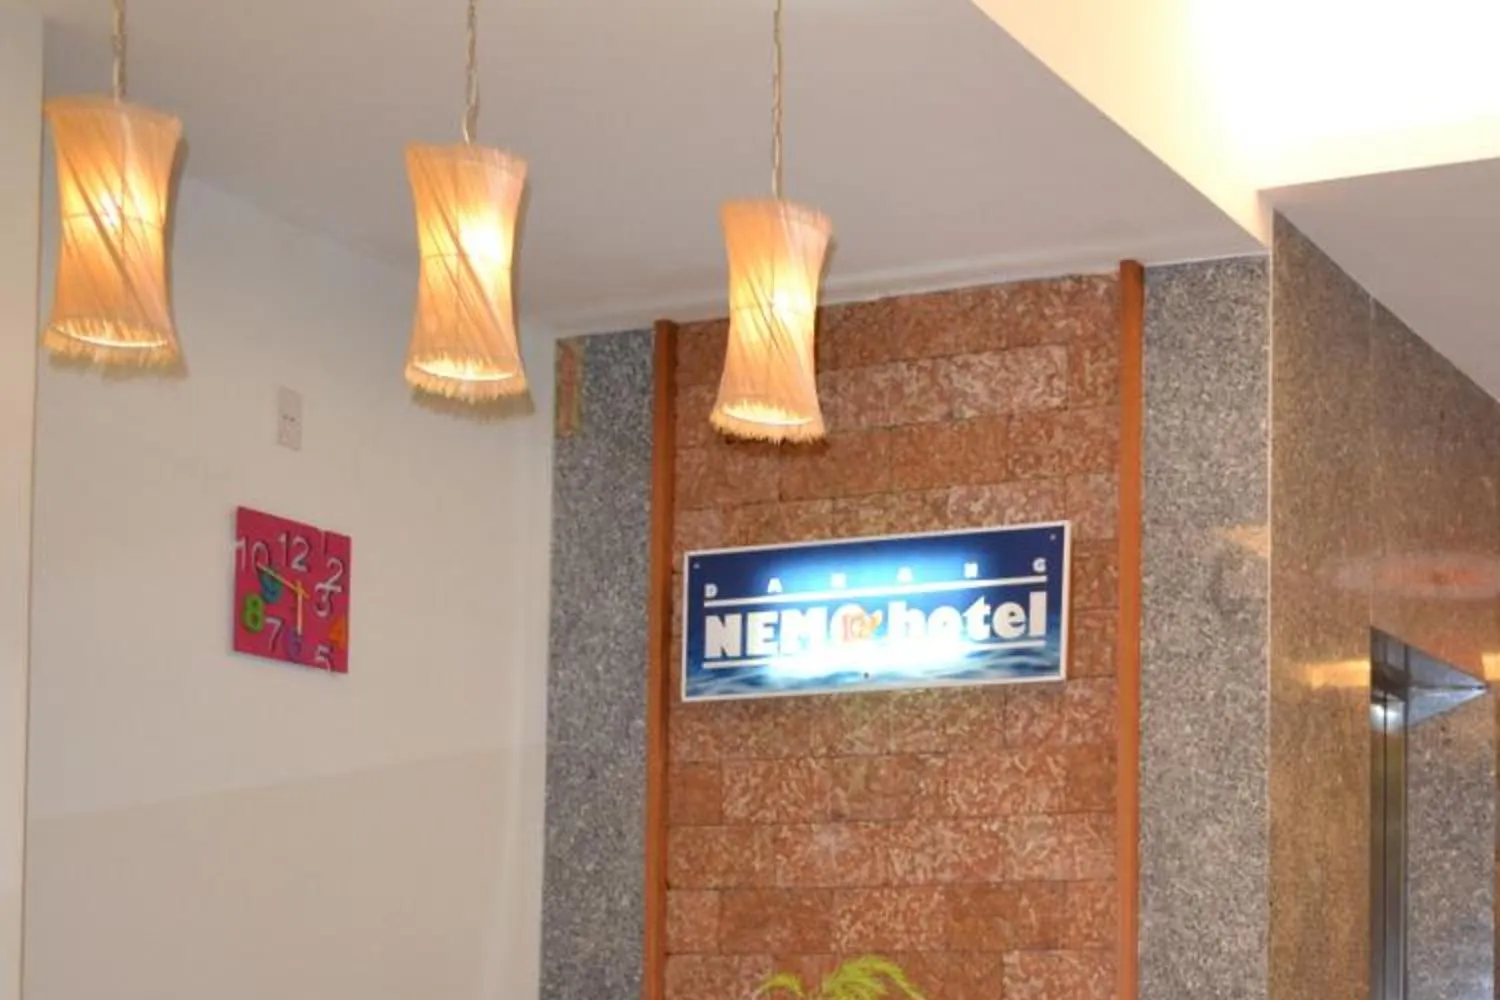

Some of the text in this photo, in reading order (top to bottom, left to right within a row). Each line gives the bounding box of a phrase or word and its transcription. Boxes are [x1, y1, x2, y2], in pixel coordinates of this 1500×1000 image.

[236, 537, 269, 576] 10
[278, 532, 310, 572] 12
[315, 557, 343, 593] 2
[241, 593, 265, 633] 8
[888, 591, 1047, 646] hotel
[266, 616, 283, 651] 7
[315, 644, 332, 672] 5
